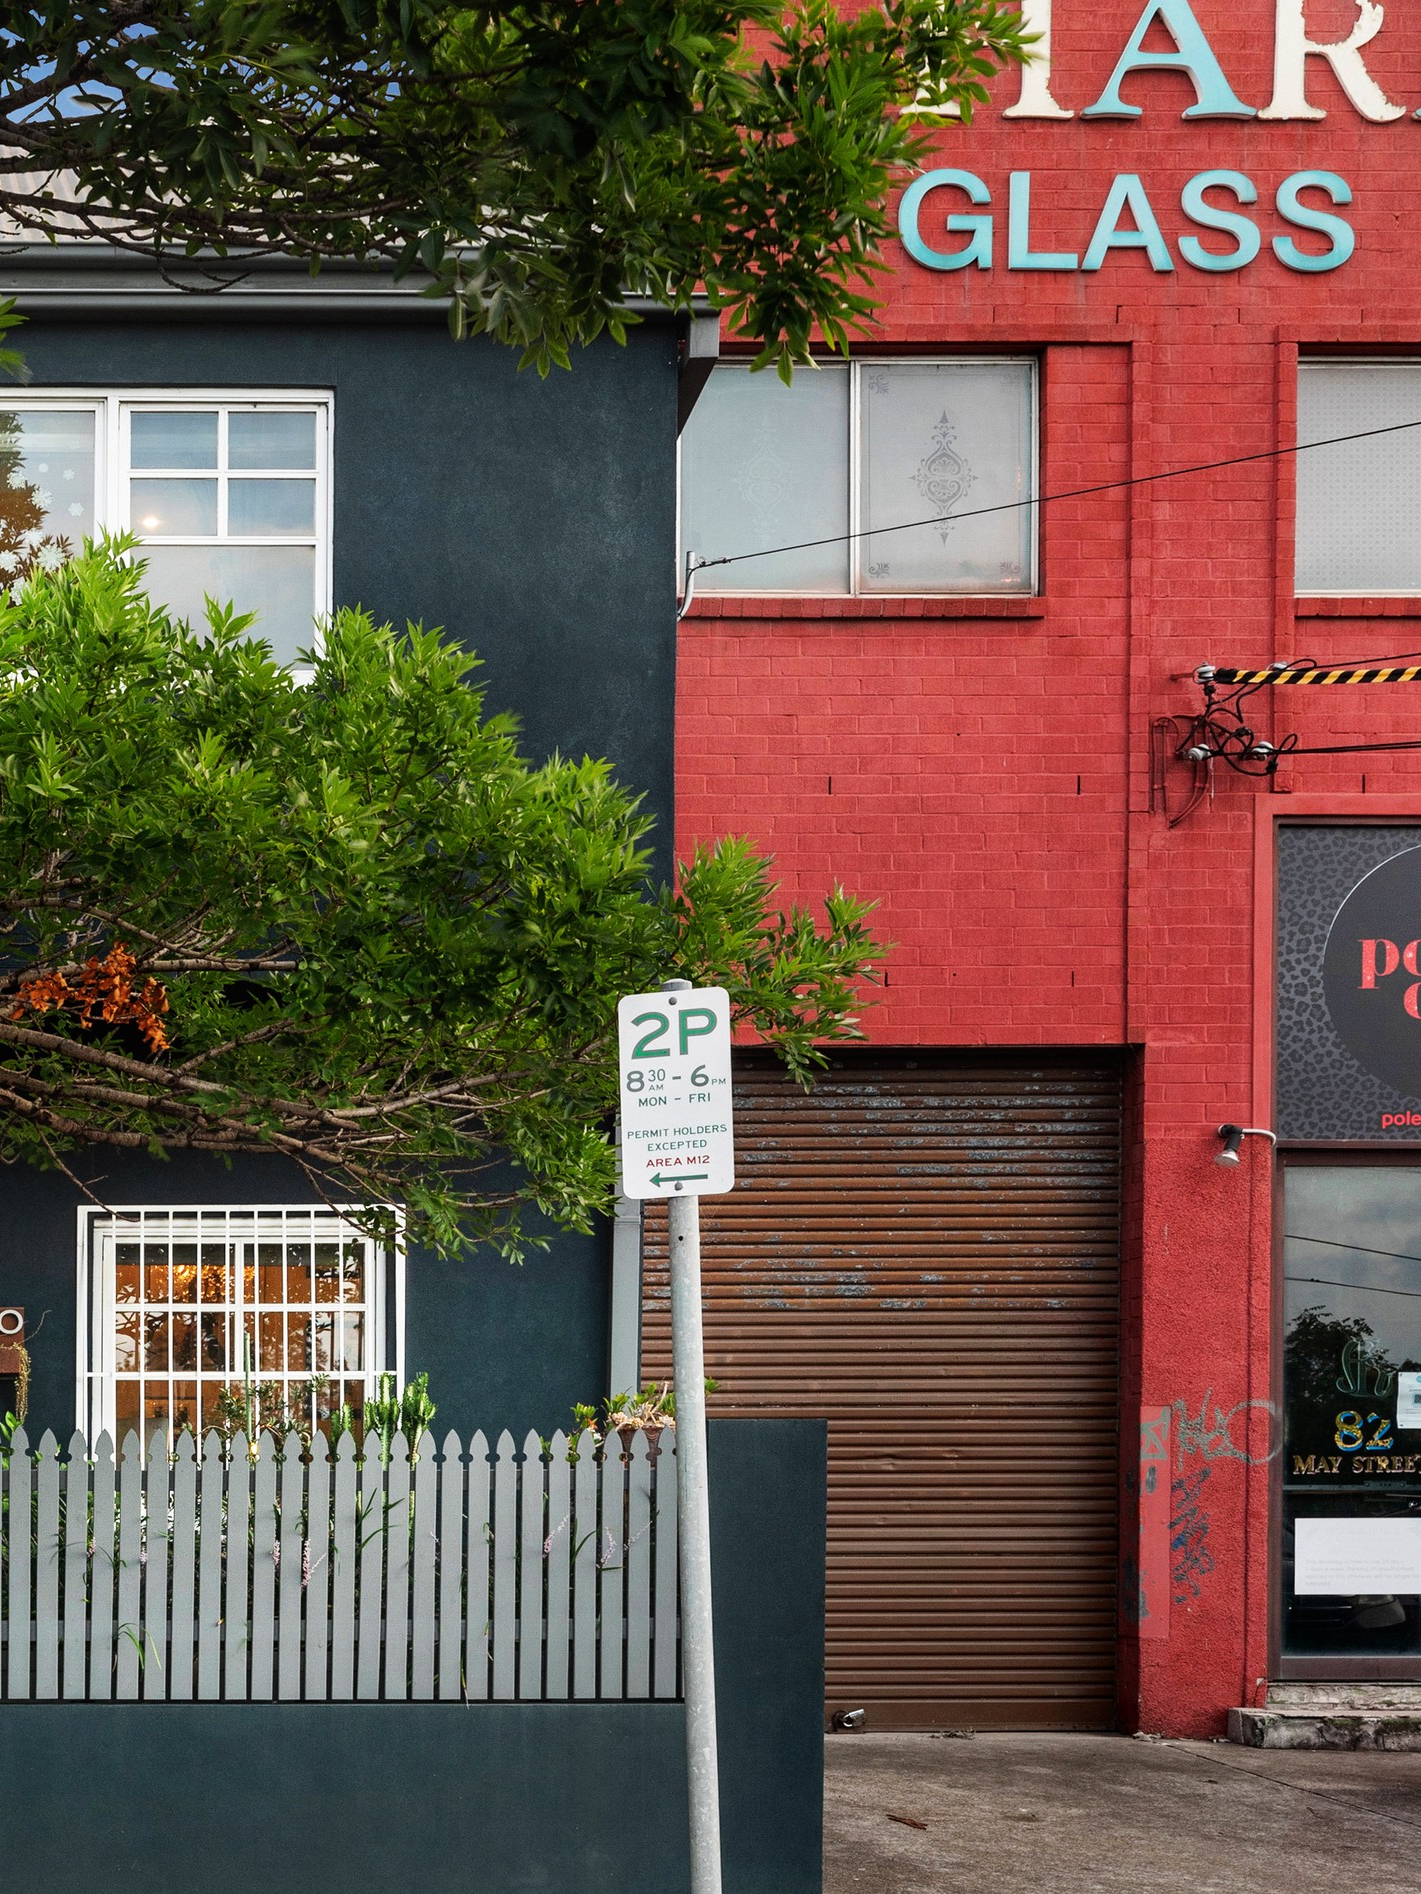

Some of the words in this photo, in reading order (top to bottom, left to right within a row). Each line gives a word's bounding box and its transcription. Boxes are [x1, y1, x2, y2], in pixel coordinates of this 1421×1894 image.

[897, 168, 1356, 273] GLASS
[631, 1008, 717, 1060] 2P
[638, 1096, 667, 1107] MON
[689, 1093, 711, 1103] FRI
[627, 1129, 669, 1140] PERMIT
[673, 1124, 728, 1136] HOLDERS
[647, 1139, 708, 1152] EXCEPTED
[646, 1158, 682, 1168] AREA
[686, 1155, 710, 1165] M12
[1334, 1410, 1394, 1452] 82
[1292, 1454, 1343, 1475] MAY
